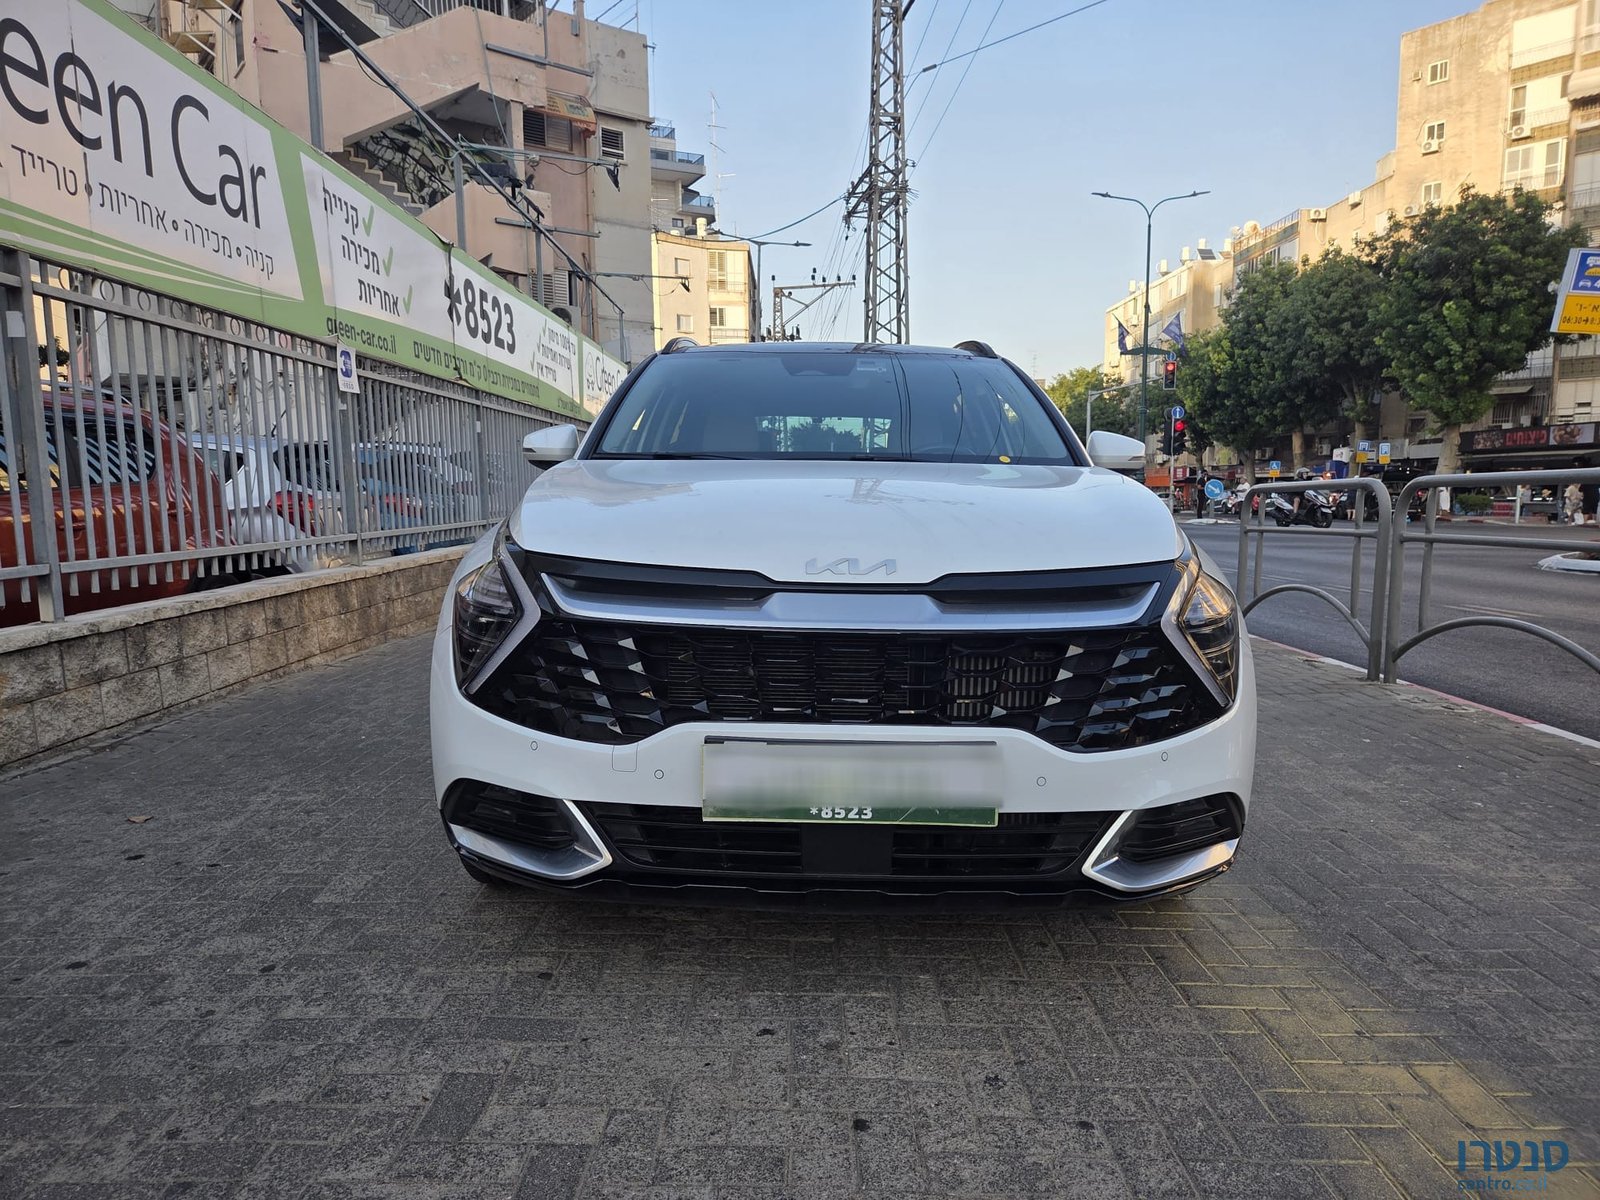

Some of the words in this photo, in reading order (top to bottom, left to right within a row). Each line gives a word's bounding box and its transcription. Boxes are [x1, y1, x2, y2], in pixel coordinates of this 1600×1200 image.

[11, 144, 78, 196] טרייד
[171, 94, 266, 229] Car
[99, 182, 168, 233] אחריות
[322, 186, 359, 235] קנייה
[184, 219, 232, 258] מכירה
[341, 235, 380, 275] מכירה
[245, 245, 274, 280] קניה
[358, 279, 400, 317] אחריות
[326, 317, 397, 355] green-car.co.il
[413, 340, 442, 367] חדשים
